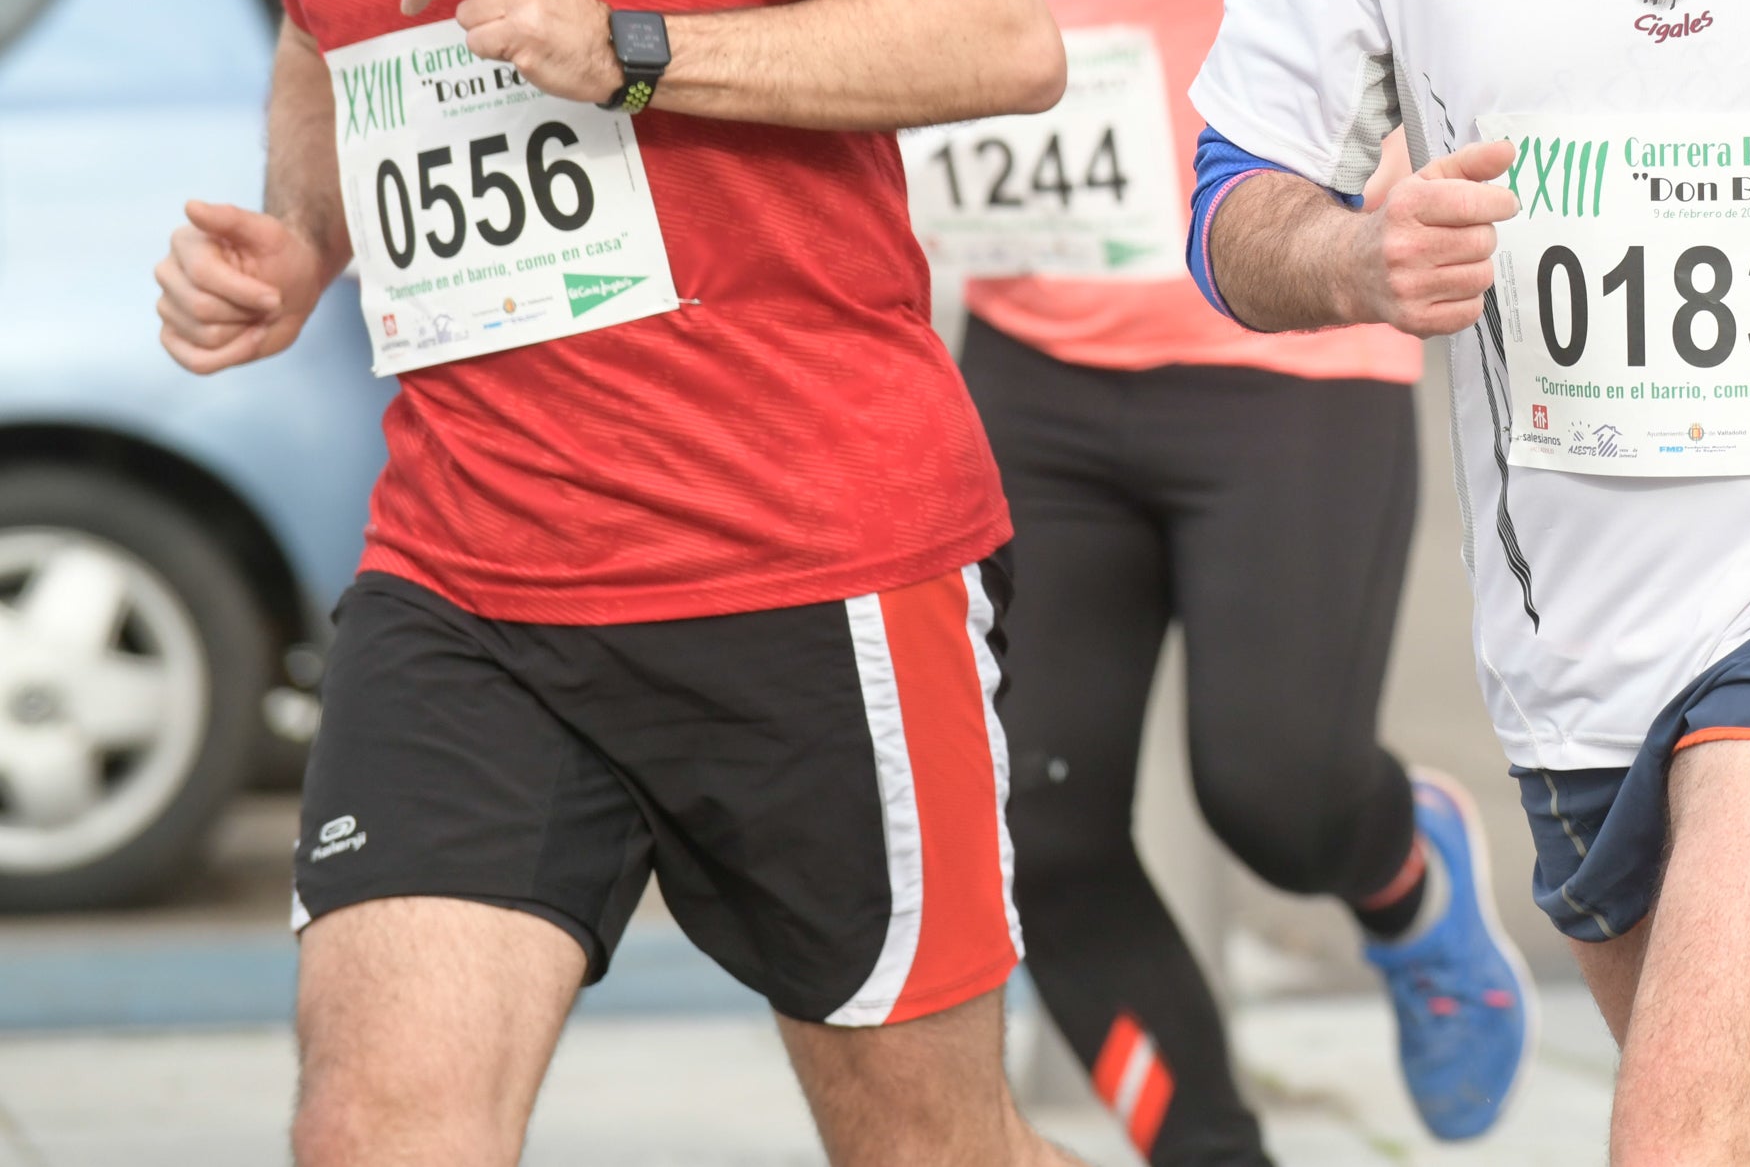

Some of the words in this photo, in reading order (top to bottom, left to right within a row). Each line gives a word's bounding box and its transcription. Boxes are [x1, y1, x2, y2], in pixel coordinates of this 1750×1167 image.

[1633, 10, 1714, 43] Cigales
[342, 56, 406, 142] XXIII
[1624, 136, 1732, 168] Carrera
[930, 128, 1128, 208] 1244
[376, 120, 595, 270] 0556
[1653, 208, 1660, 219] 9
[1663, 208, 1676, 219] de
[1679, 208, 1722, 219] febrero
[1725, 207, 1738, 219] de
[516, 253, 557, 273] como
[562, 246, 580, 262] en
[1606, 384, 1624, 399] en
[1630, 381, 1644, 399] el
[1651, 381, 1707, 401] barrio,
[1523, 432, 1561, 446] salesianos
[1659, 445, 1684, 453] FMD
